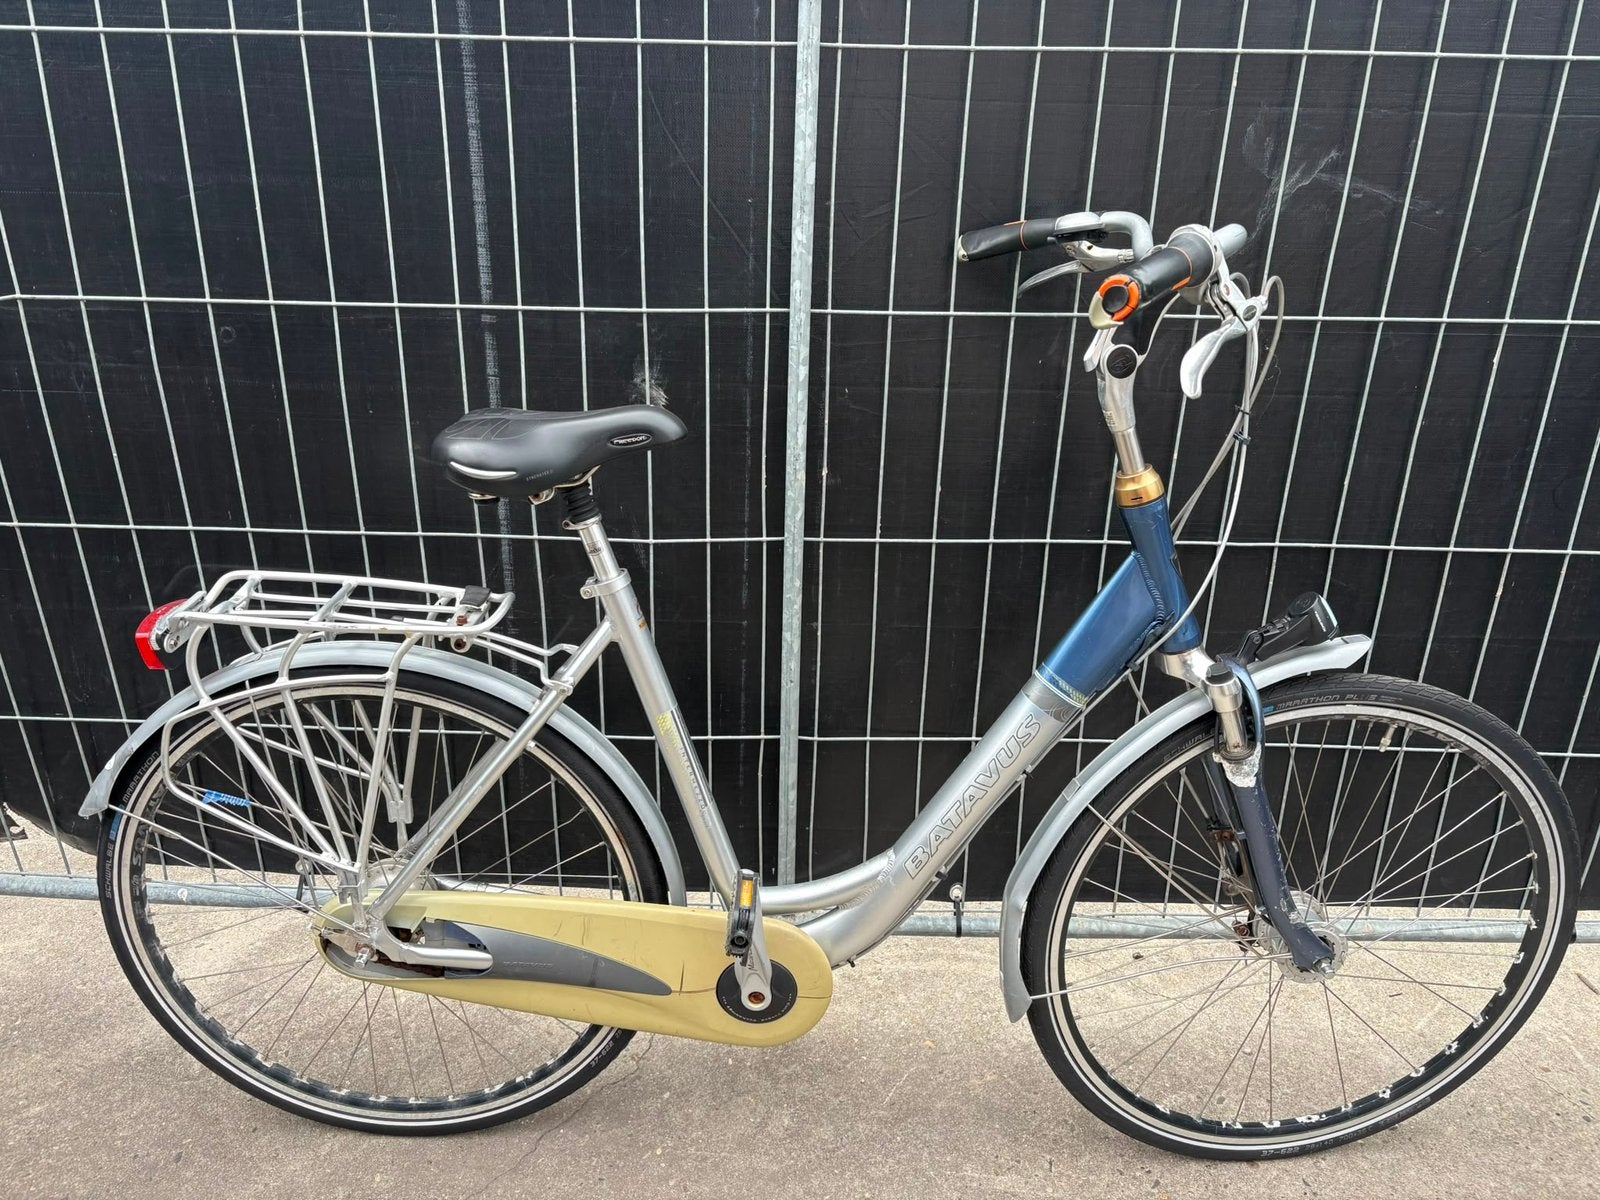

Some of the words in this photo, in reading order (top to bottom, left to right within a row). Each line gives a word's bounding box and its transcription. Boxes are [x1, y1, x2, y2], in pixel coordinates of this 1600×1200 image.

[1276, 694, 1340, 711] MARATHON
[104, 842, 115, 900] SCHWALBE
[122, 751, 160, 804] MARATHON
[904, 714, 1041, 880] BATAVUS
[1260, 1147, 1300, 1157] 37-622
